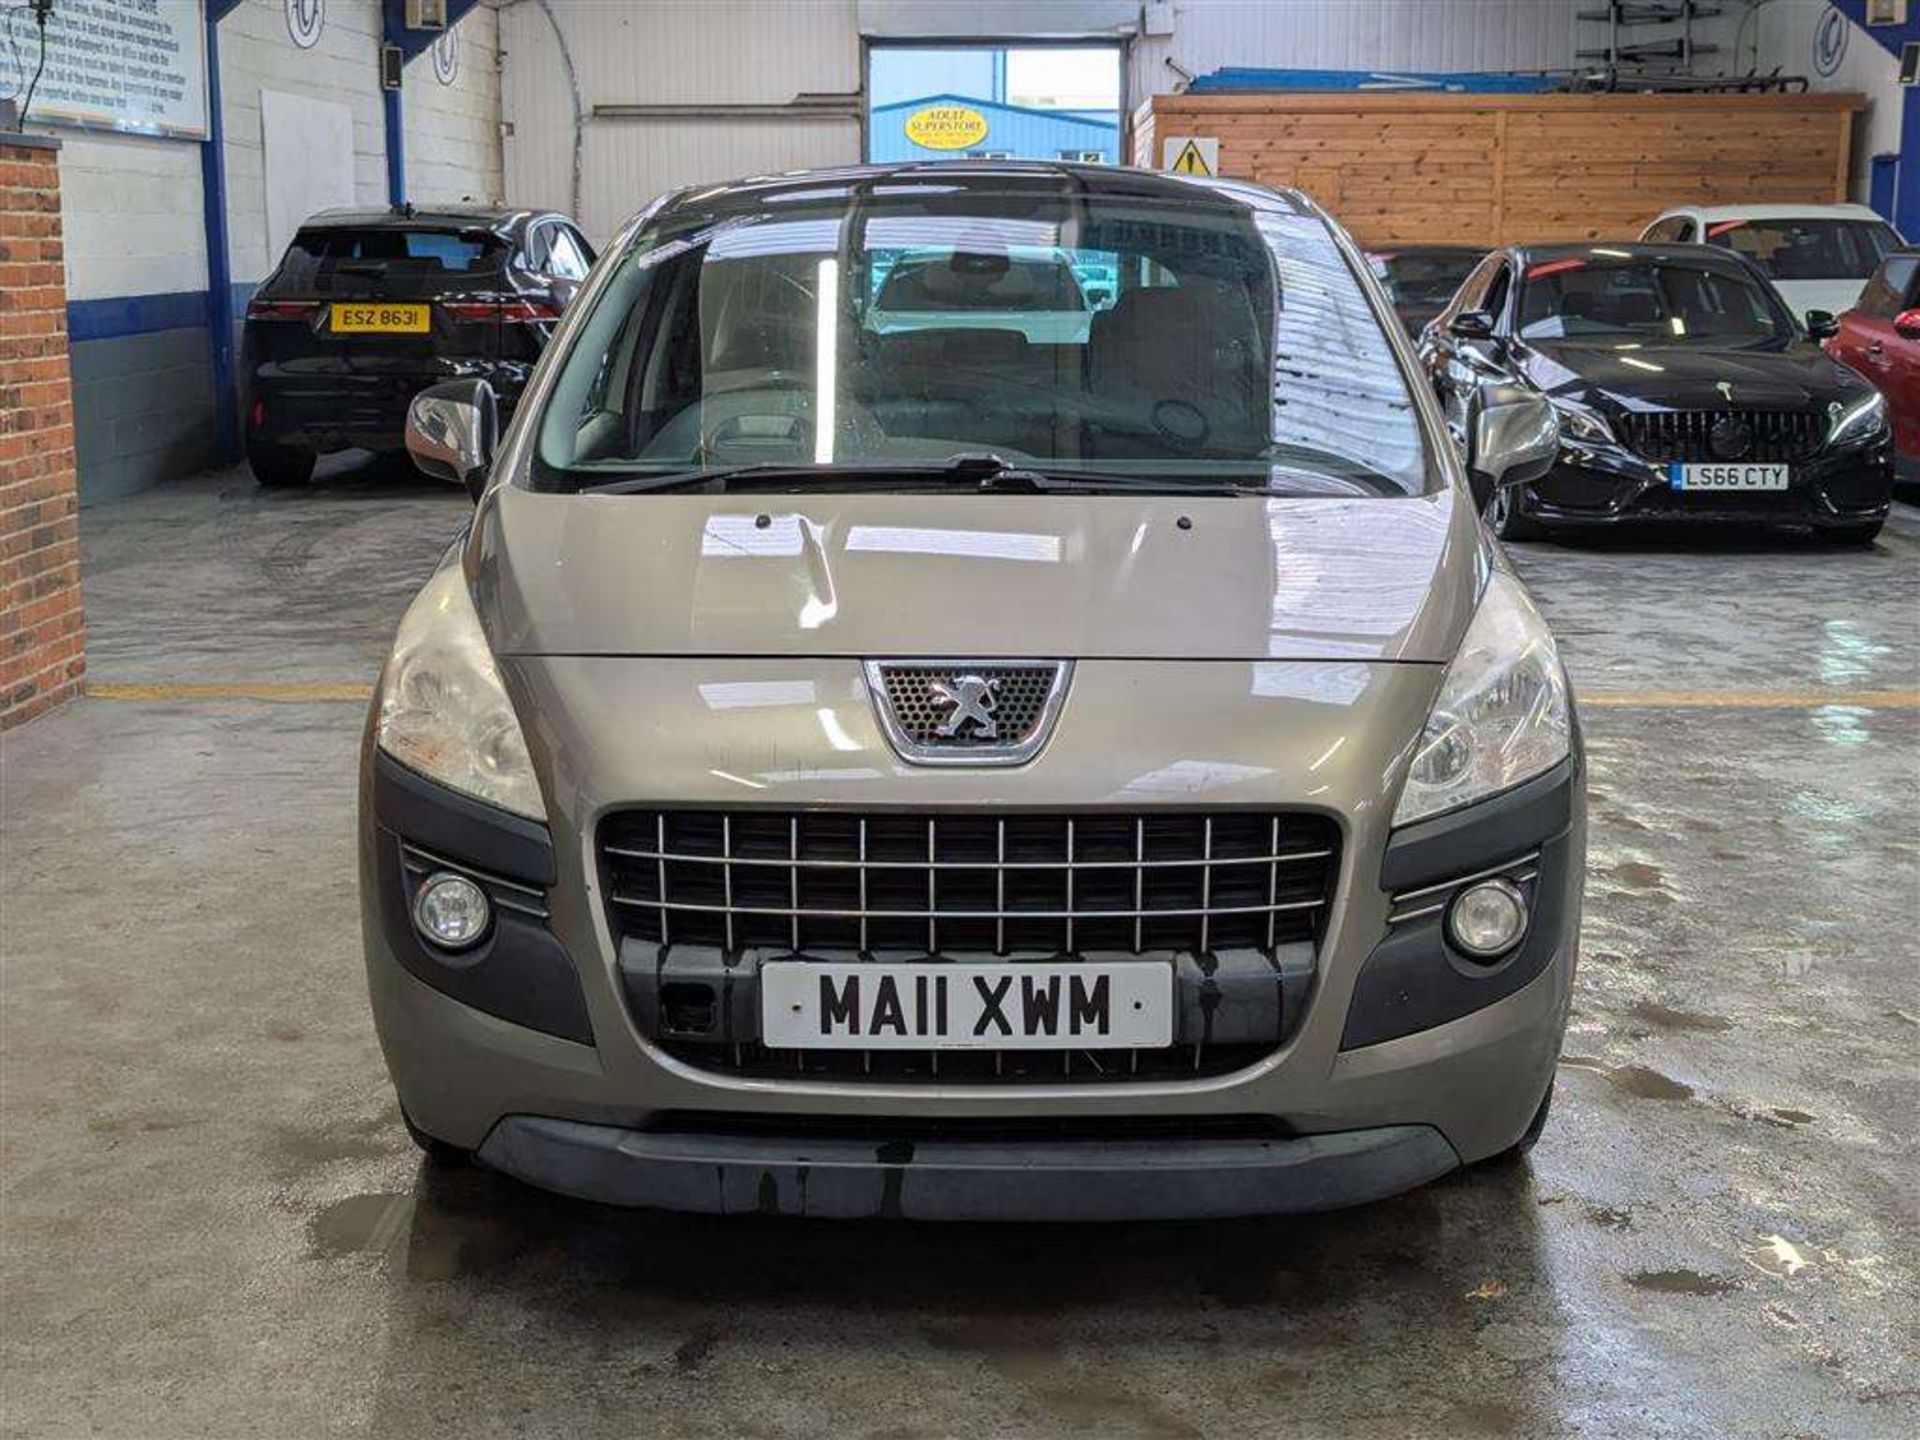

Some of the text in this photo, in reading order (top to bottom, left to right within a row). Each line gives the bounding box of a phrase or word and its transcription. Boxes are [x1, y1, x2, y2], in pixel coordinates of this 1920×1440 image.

[343, 310, 418, 325] ESZ 8631
[1686, 467, 1739, 486] LS66
[1744, 467, 1783, 486] CTY
[819, 975, 1111, 1036] MA11 XWM
